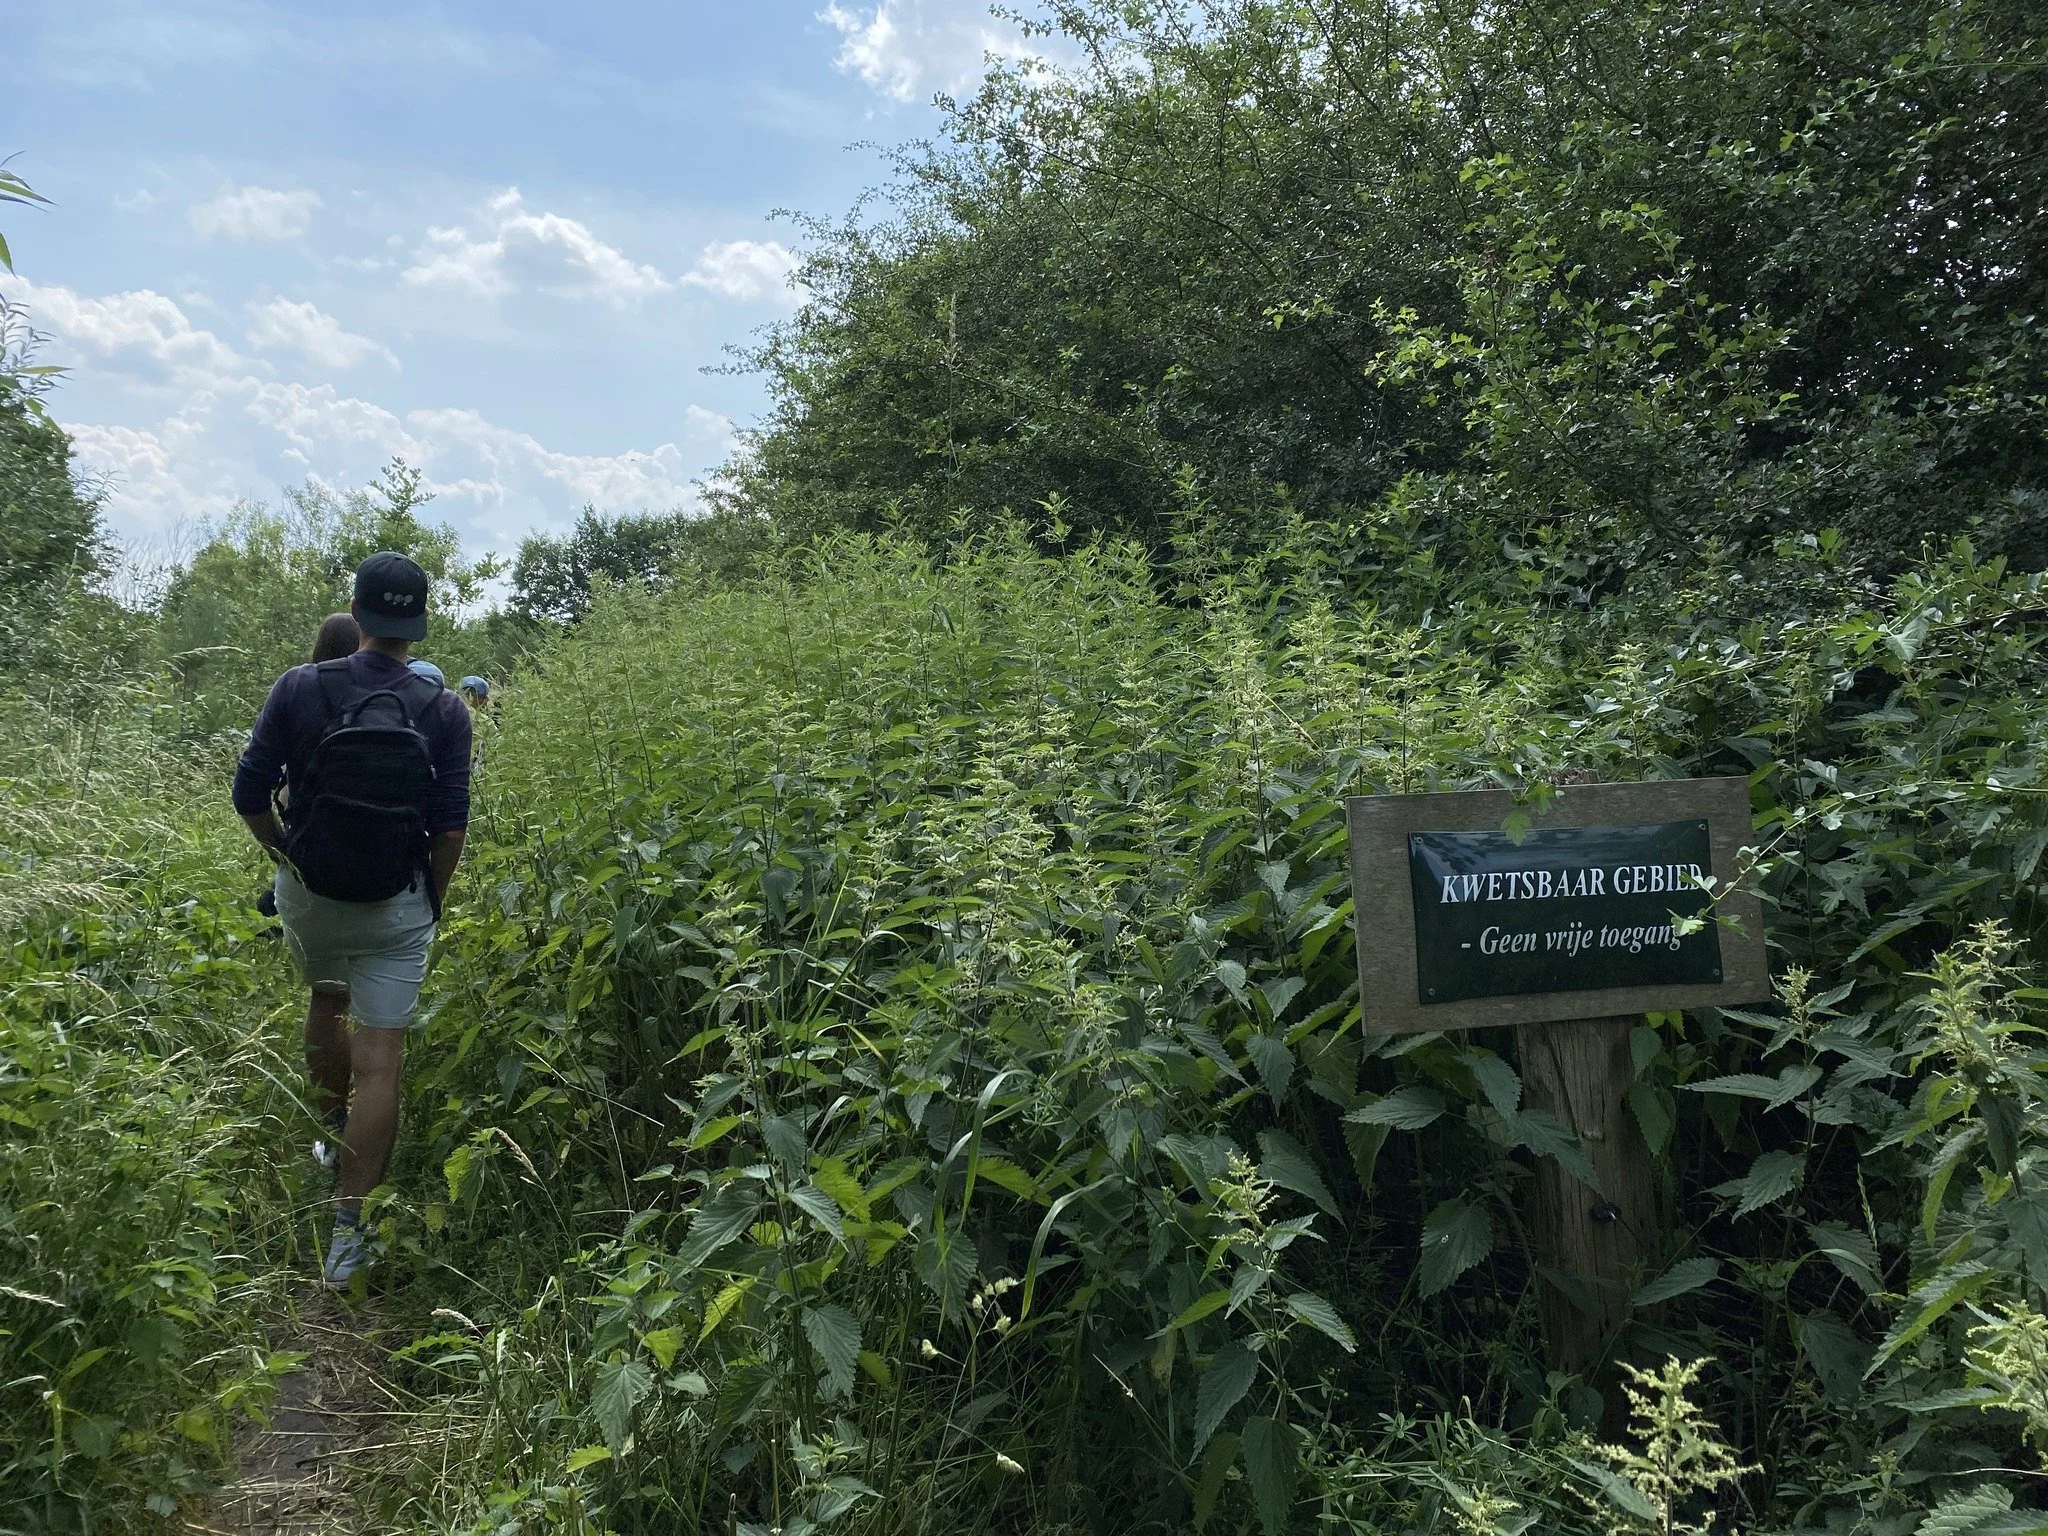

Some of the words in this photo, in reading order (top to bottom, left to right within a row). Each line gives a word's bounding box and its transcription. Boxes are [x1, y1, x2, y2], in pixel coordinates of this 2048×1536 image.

[1440, 868, 1606, 904] KWETSBAAR
[1480, 926, 1537, 955] Geen
[1545, 922, 1592, 957] vrije
